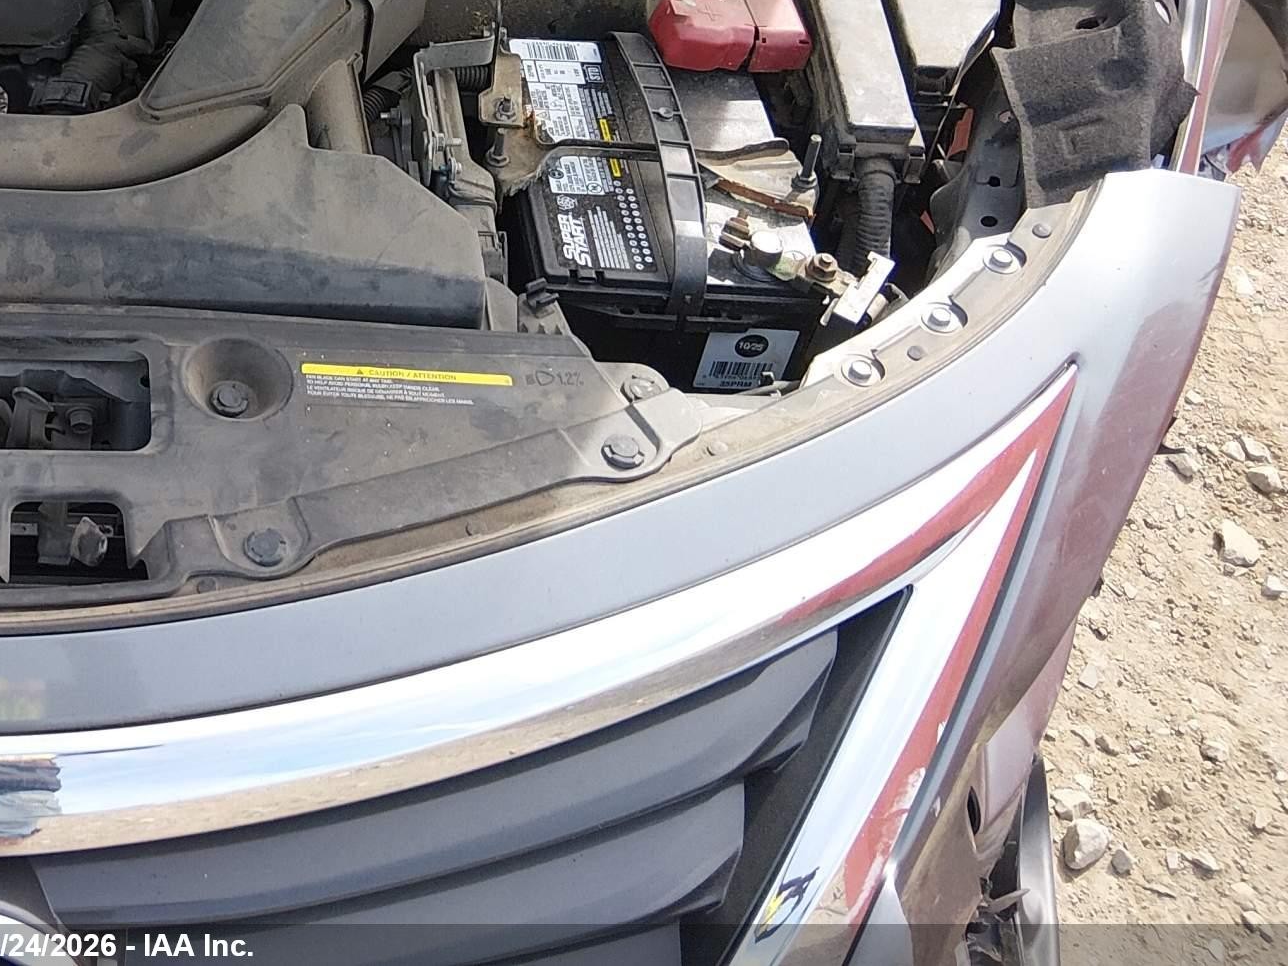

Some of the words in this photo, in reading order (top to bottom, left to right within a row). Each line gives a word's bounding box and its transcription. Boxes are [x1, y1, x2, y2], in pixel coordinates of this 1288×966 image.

[557, 212, 573, 260] SUPER
[569, 215, 593, 268] START
[738, 341, 765, 352] 10/25
[368, 369, 405, 378] CAUTION
[413, 372, 457, 381] ATTENTION
